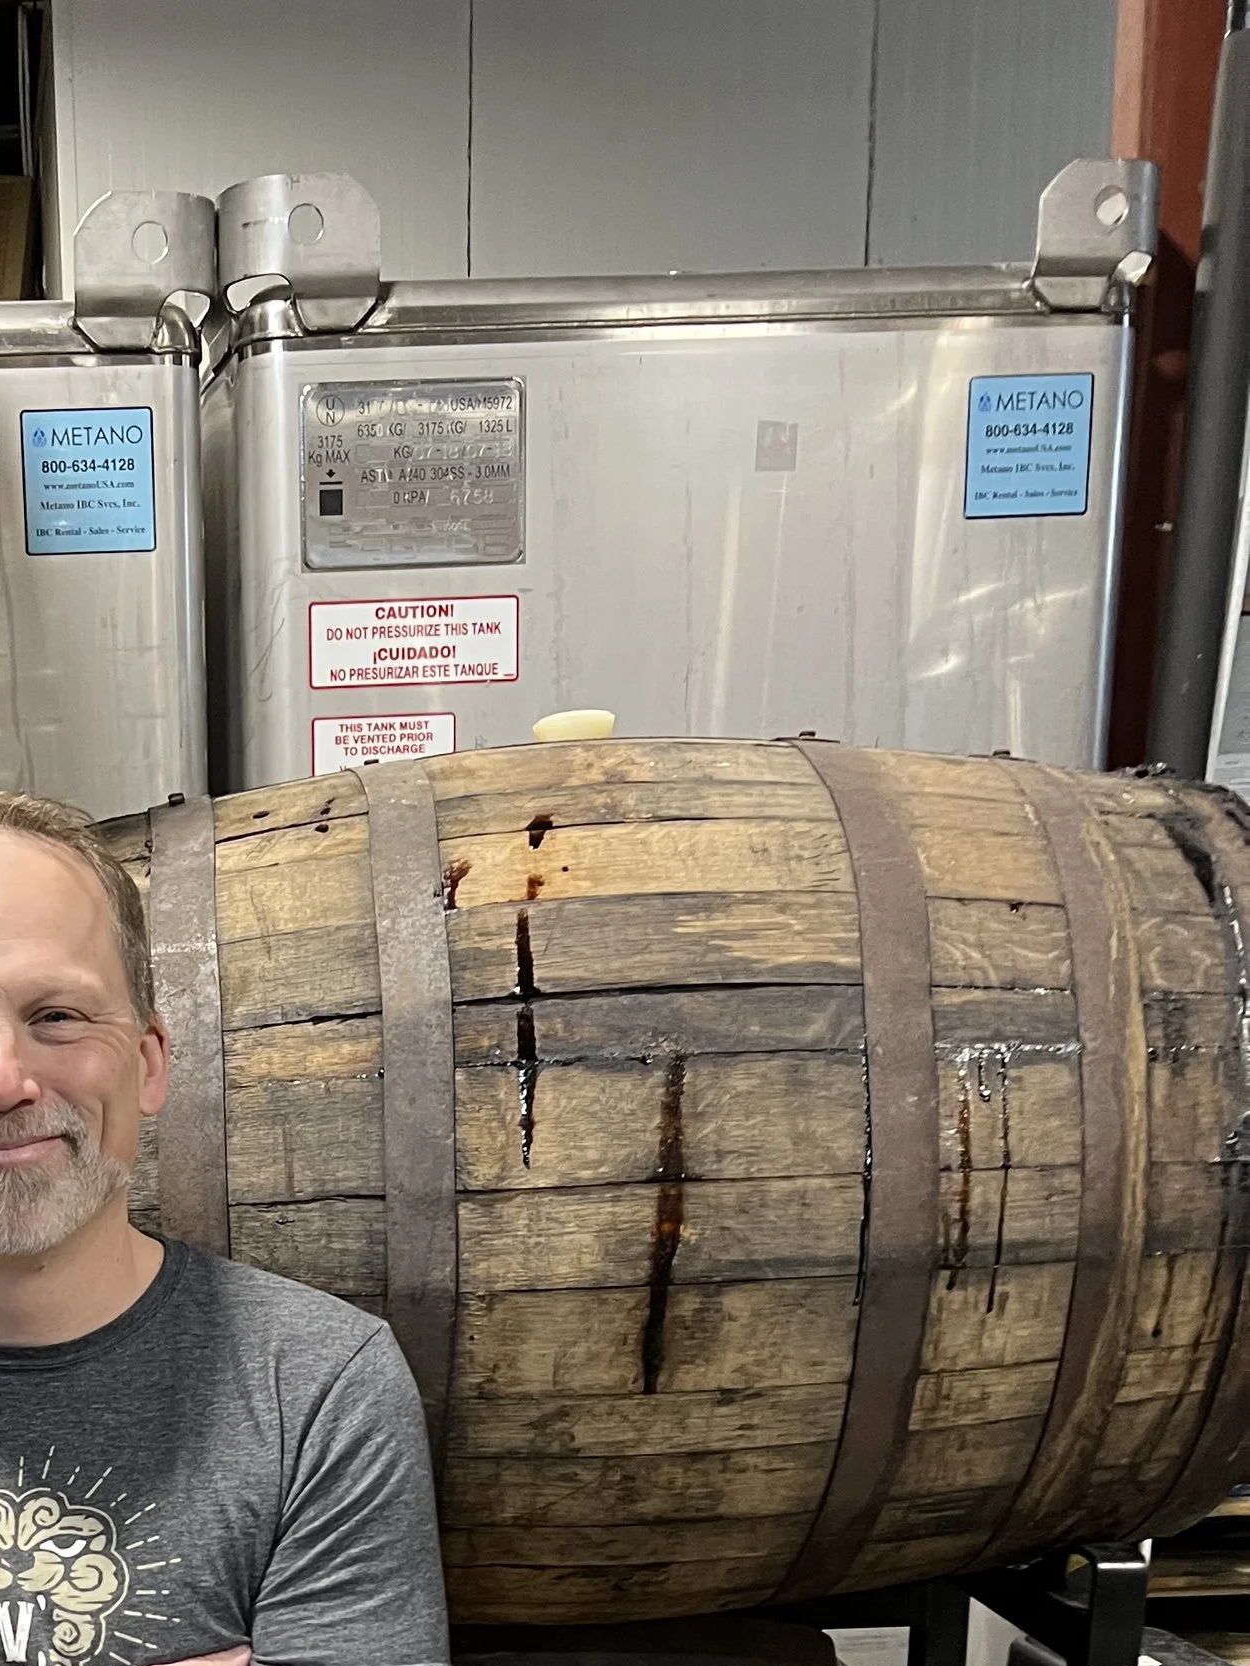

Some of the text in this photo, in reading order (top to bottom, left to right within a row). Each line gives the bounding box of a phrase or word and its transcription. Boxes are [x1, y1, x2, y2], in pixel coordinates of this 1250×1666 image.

[995, 389, 1084, 412] METANO
[51, 425, 143, 447] METANO
[357, 423, 384, 438] 6350
[418, 421, 444, 436] 3175
[985, 422, 1074, 438] 800-634-4128
[317, 435, 343, 449] 3175
[41, 458, 135, 474] 800-634-4128
[308, 451, 350, 466] Kg MAX
[43, 480, 136, 491] www.metanoUSA.com
[40, 500, 75, 511] Metano
[76, 499, 96, 510] IBC
[122, 498, 141, 509] Inc.
[36, 528, 53, 537] IBC
[54, 527, 82, 537] Rental
[88, 526, 110, 536] Sales
[116, 525, 146, 535] Service
[375, 604, 454, 620] CAUTION!
[326, 621, 502, 641] DO NOT PRESSURIZE THIS TANK
[373, 645, 457, 664] ¡CUIDADO!
[330, 662, 499, 682] NO PRESURIZAR ESTE TANQUE
[339, 720, 430, 733] THIS TANK MUST
[335, 732, 433, 745] BE VENTED PRIOR
[343, 744, 425, 757] TO DISCHARGE
